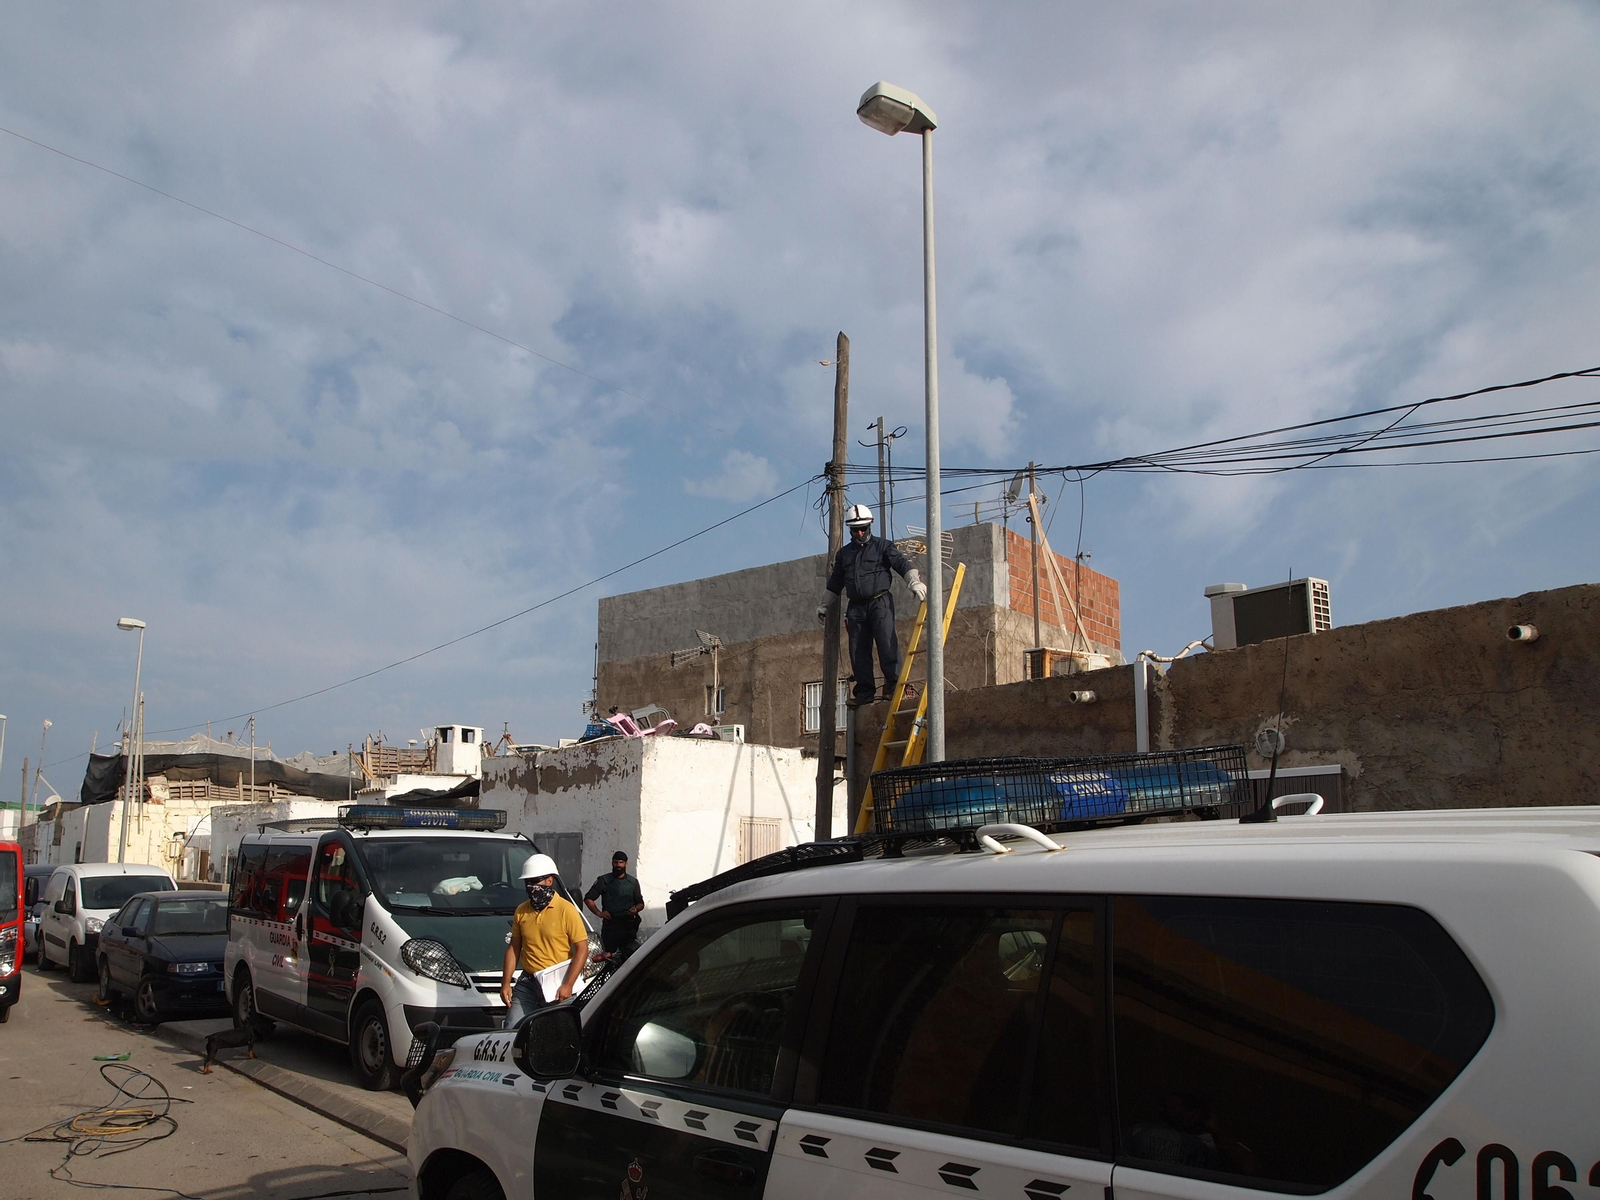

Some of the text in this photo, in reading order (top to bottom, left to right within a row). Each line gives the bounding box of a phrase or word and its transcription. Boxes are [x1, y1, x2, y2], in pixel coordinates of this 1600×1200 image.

[409, 810, 456, 818] GUARDIA
[269, 931, 291, 948] GUARDIA
[272, 954, 285, 968] CIVIL
[454, 1069, 502, 1082] GUARDIA CIVIL
